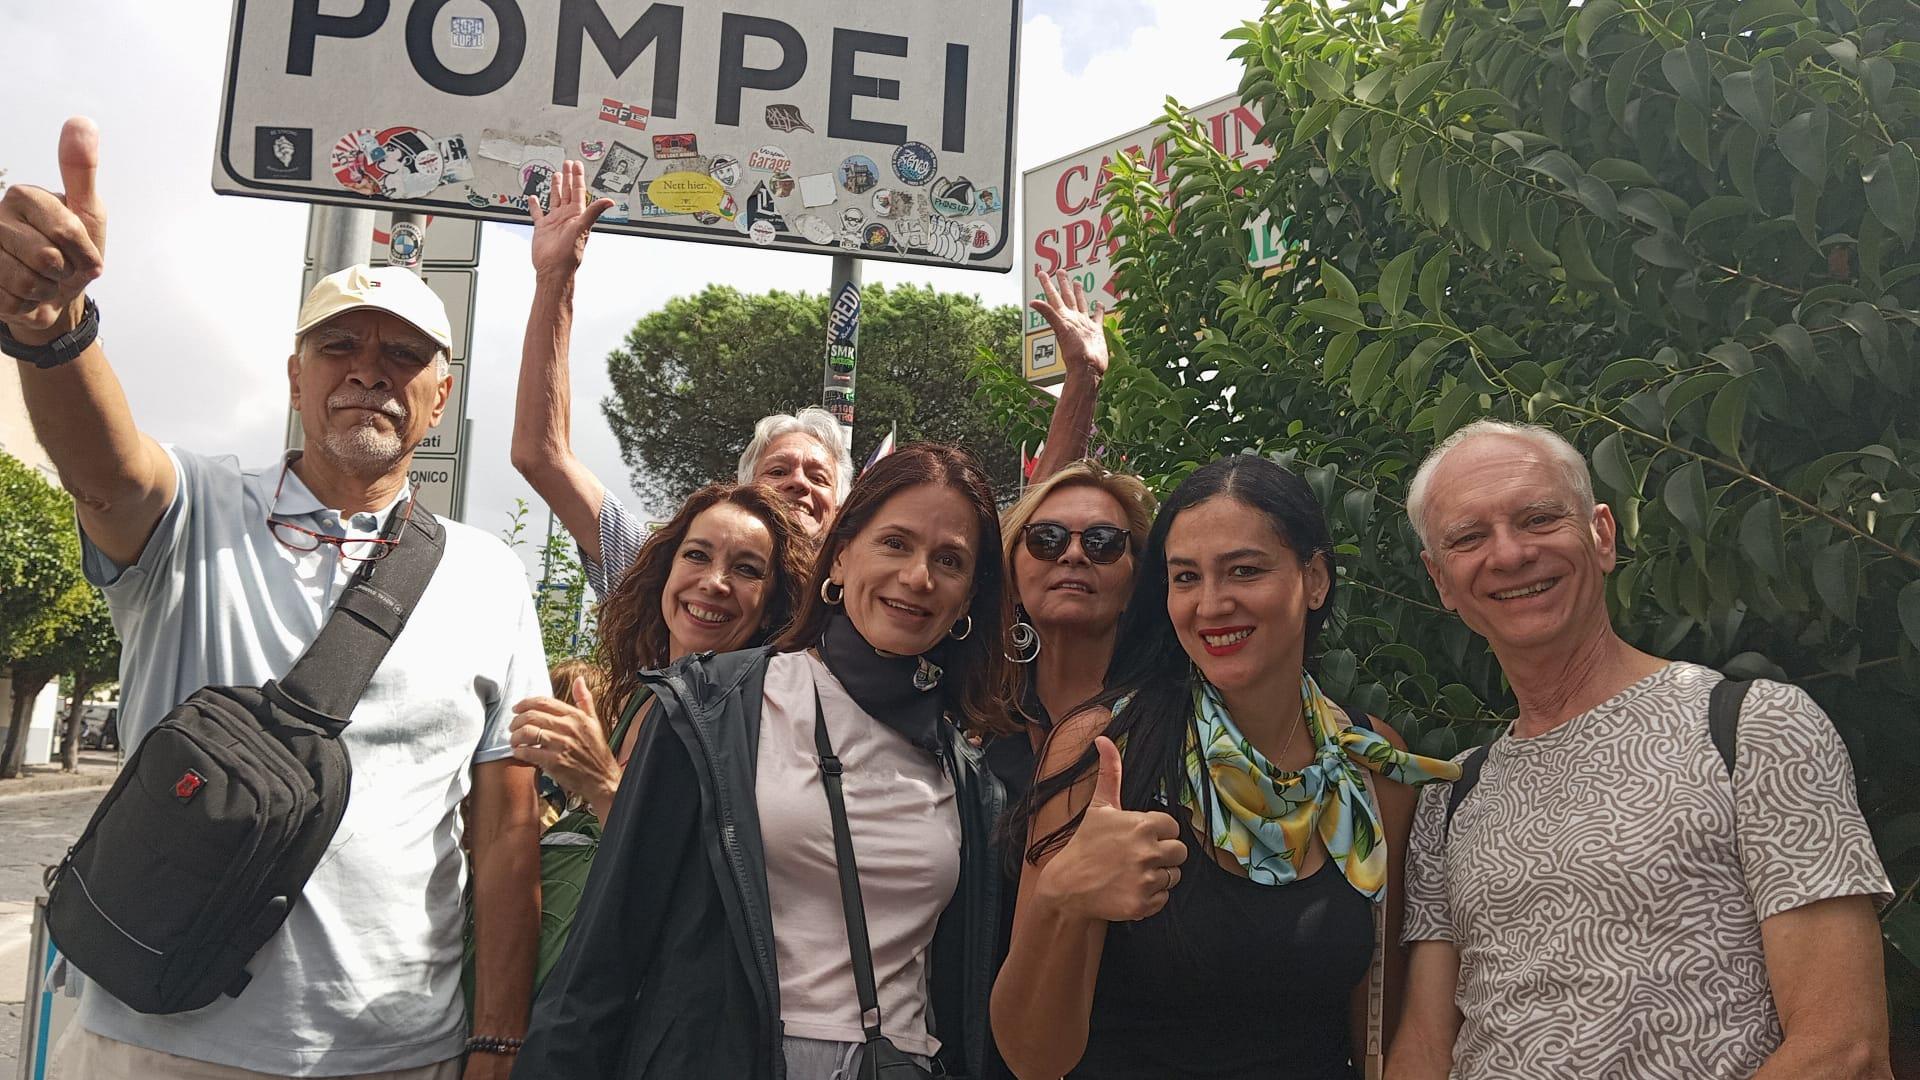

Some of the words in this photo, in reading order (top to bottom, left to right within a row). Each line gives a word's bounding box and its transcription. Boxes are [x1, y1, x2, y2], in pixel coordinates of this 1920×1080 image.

[286, 0, 969, 153] POMPEI
[601, 106, 647, 121] MFE
[748, 151, 791, 173] Garage
[664, 181, 685, 190] Nett
[687, 180, 708, 190] hier.
